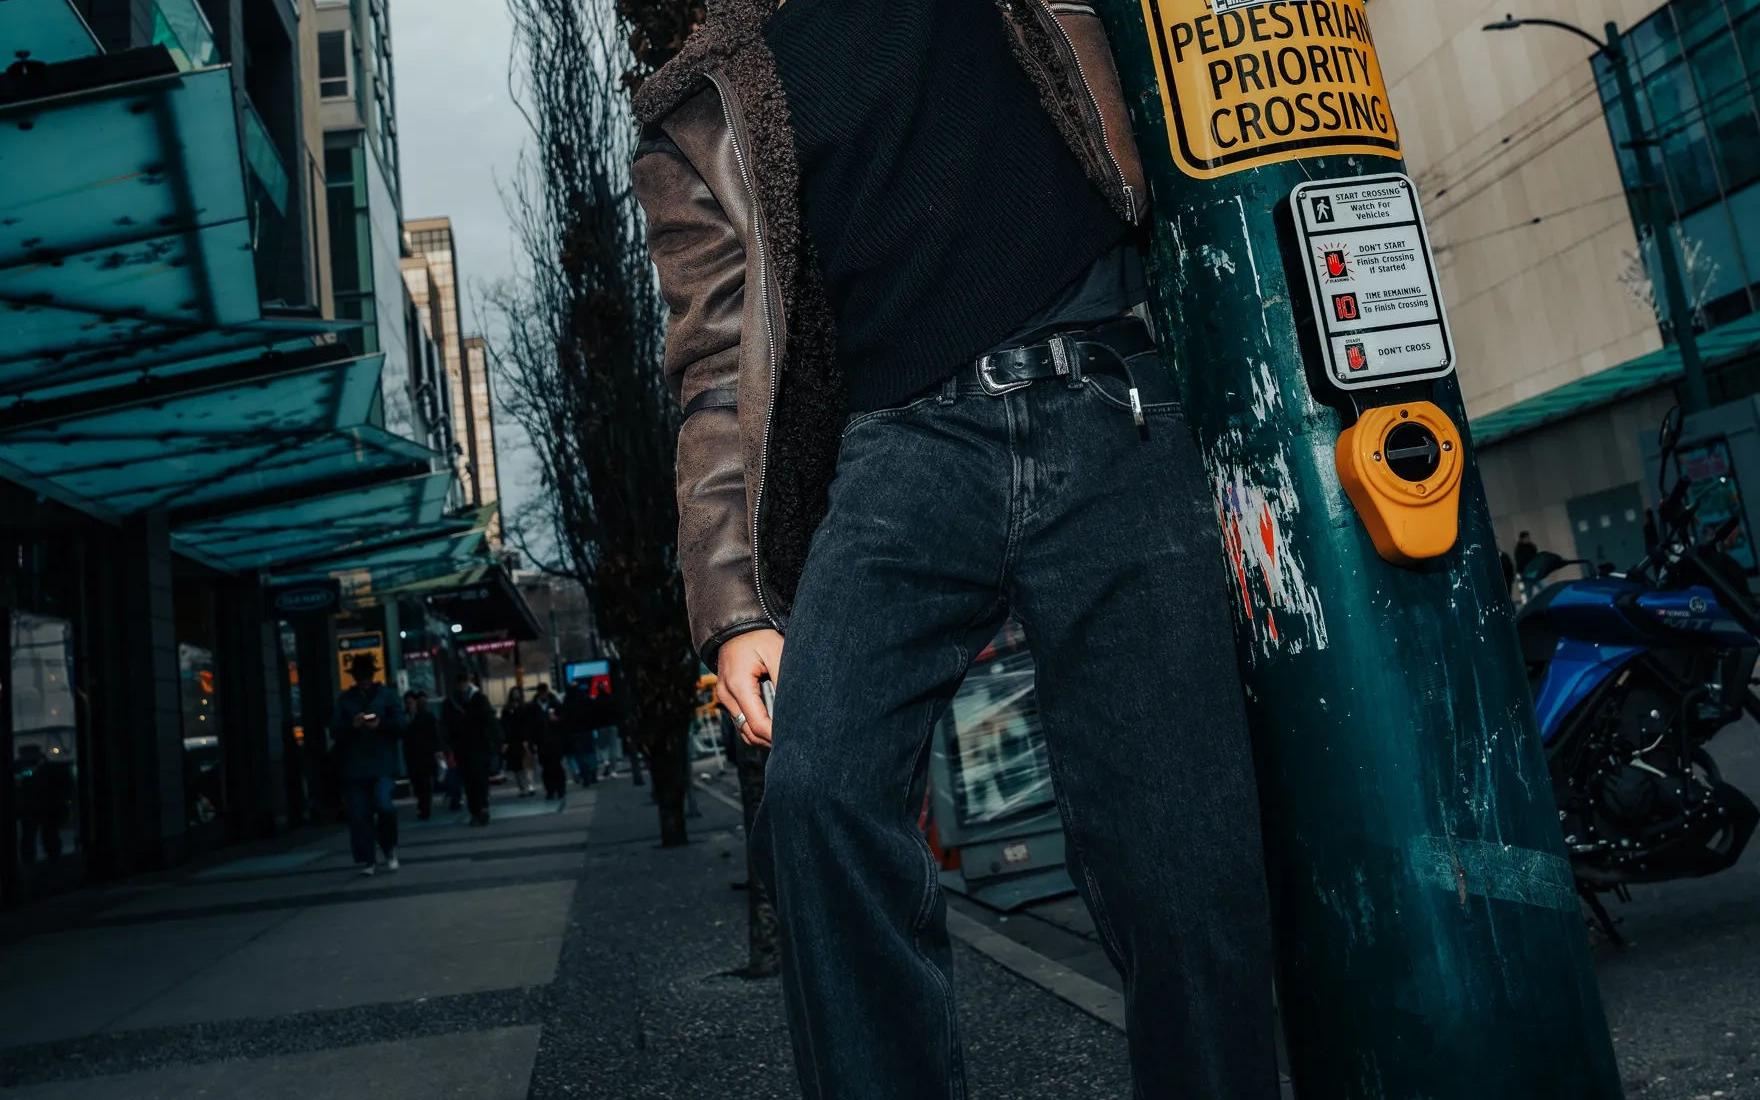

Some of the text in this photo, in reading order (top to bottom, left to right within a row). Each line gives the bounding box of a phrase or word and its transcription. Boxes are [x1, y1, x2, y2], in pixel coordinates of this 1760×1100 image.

[1170, 0, 1374, 63] PEDESTRIAN
[1208, 45, 1371, 100] PRIORITY
[1210, 91, 1389, 149] CROSSING
[1335, 187, 1400, 201] START CROSSING
[1350, 201, 1391, 212] Watch For
[1356, 210, 1390, 220] Vehicles
[1359, 240, 1406, 253] DON'T START
[1356, 253, 1415, 266] Finish Crossing
[1369, 263, 1406, 274] If Started
[1365, 286, 1421, 300] TIME REMAINING
[1335, 295, 1356, 319] 10
[1374, 303, 1396, 312] Finish
[1397, 299, 1429, 310] Crossing
[1378, 342, 1431, 356] DON'T CROSS
